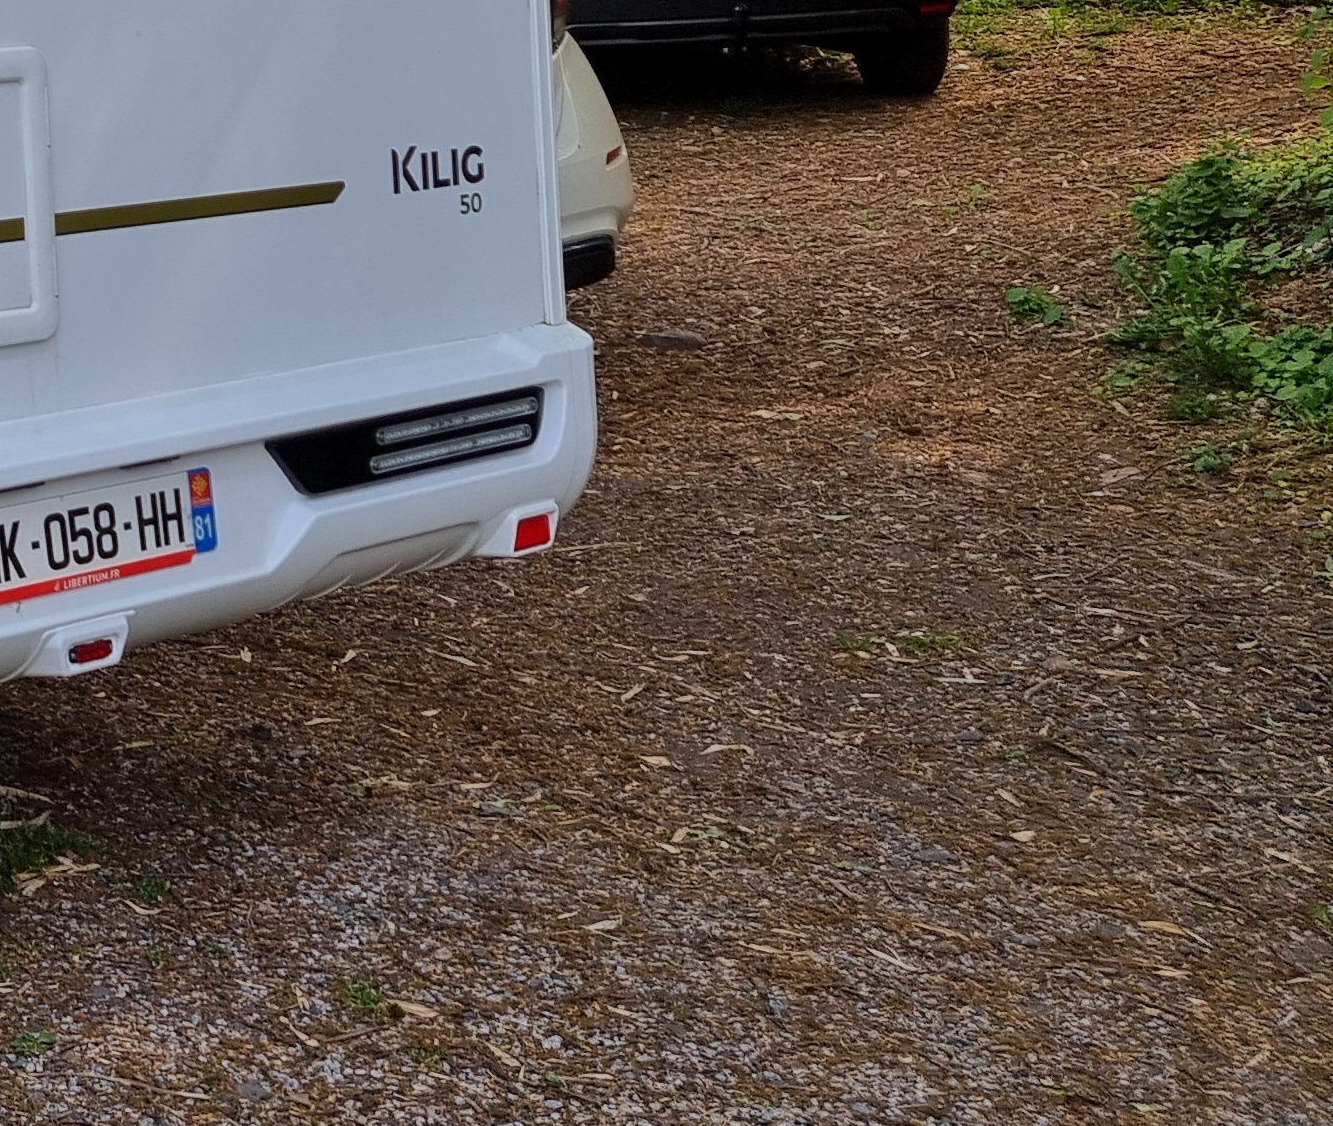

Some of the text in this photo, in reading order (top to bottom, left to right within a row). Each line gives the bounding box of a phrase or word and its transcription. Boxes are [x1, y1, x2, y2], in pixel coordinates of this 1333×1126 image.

[391, 145, 485, 194] KILIG
[460, 192, 482, 215] 50
[194, 513, 213, 542] 81
[62, 568, 121, 591] LIBERTIUM.FR
